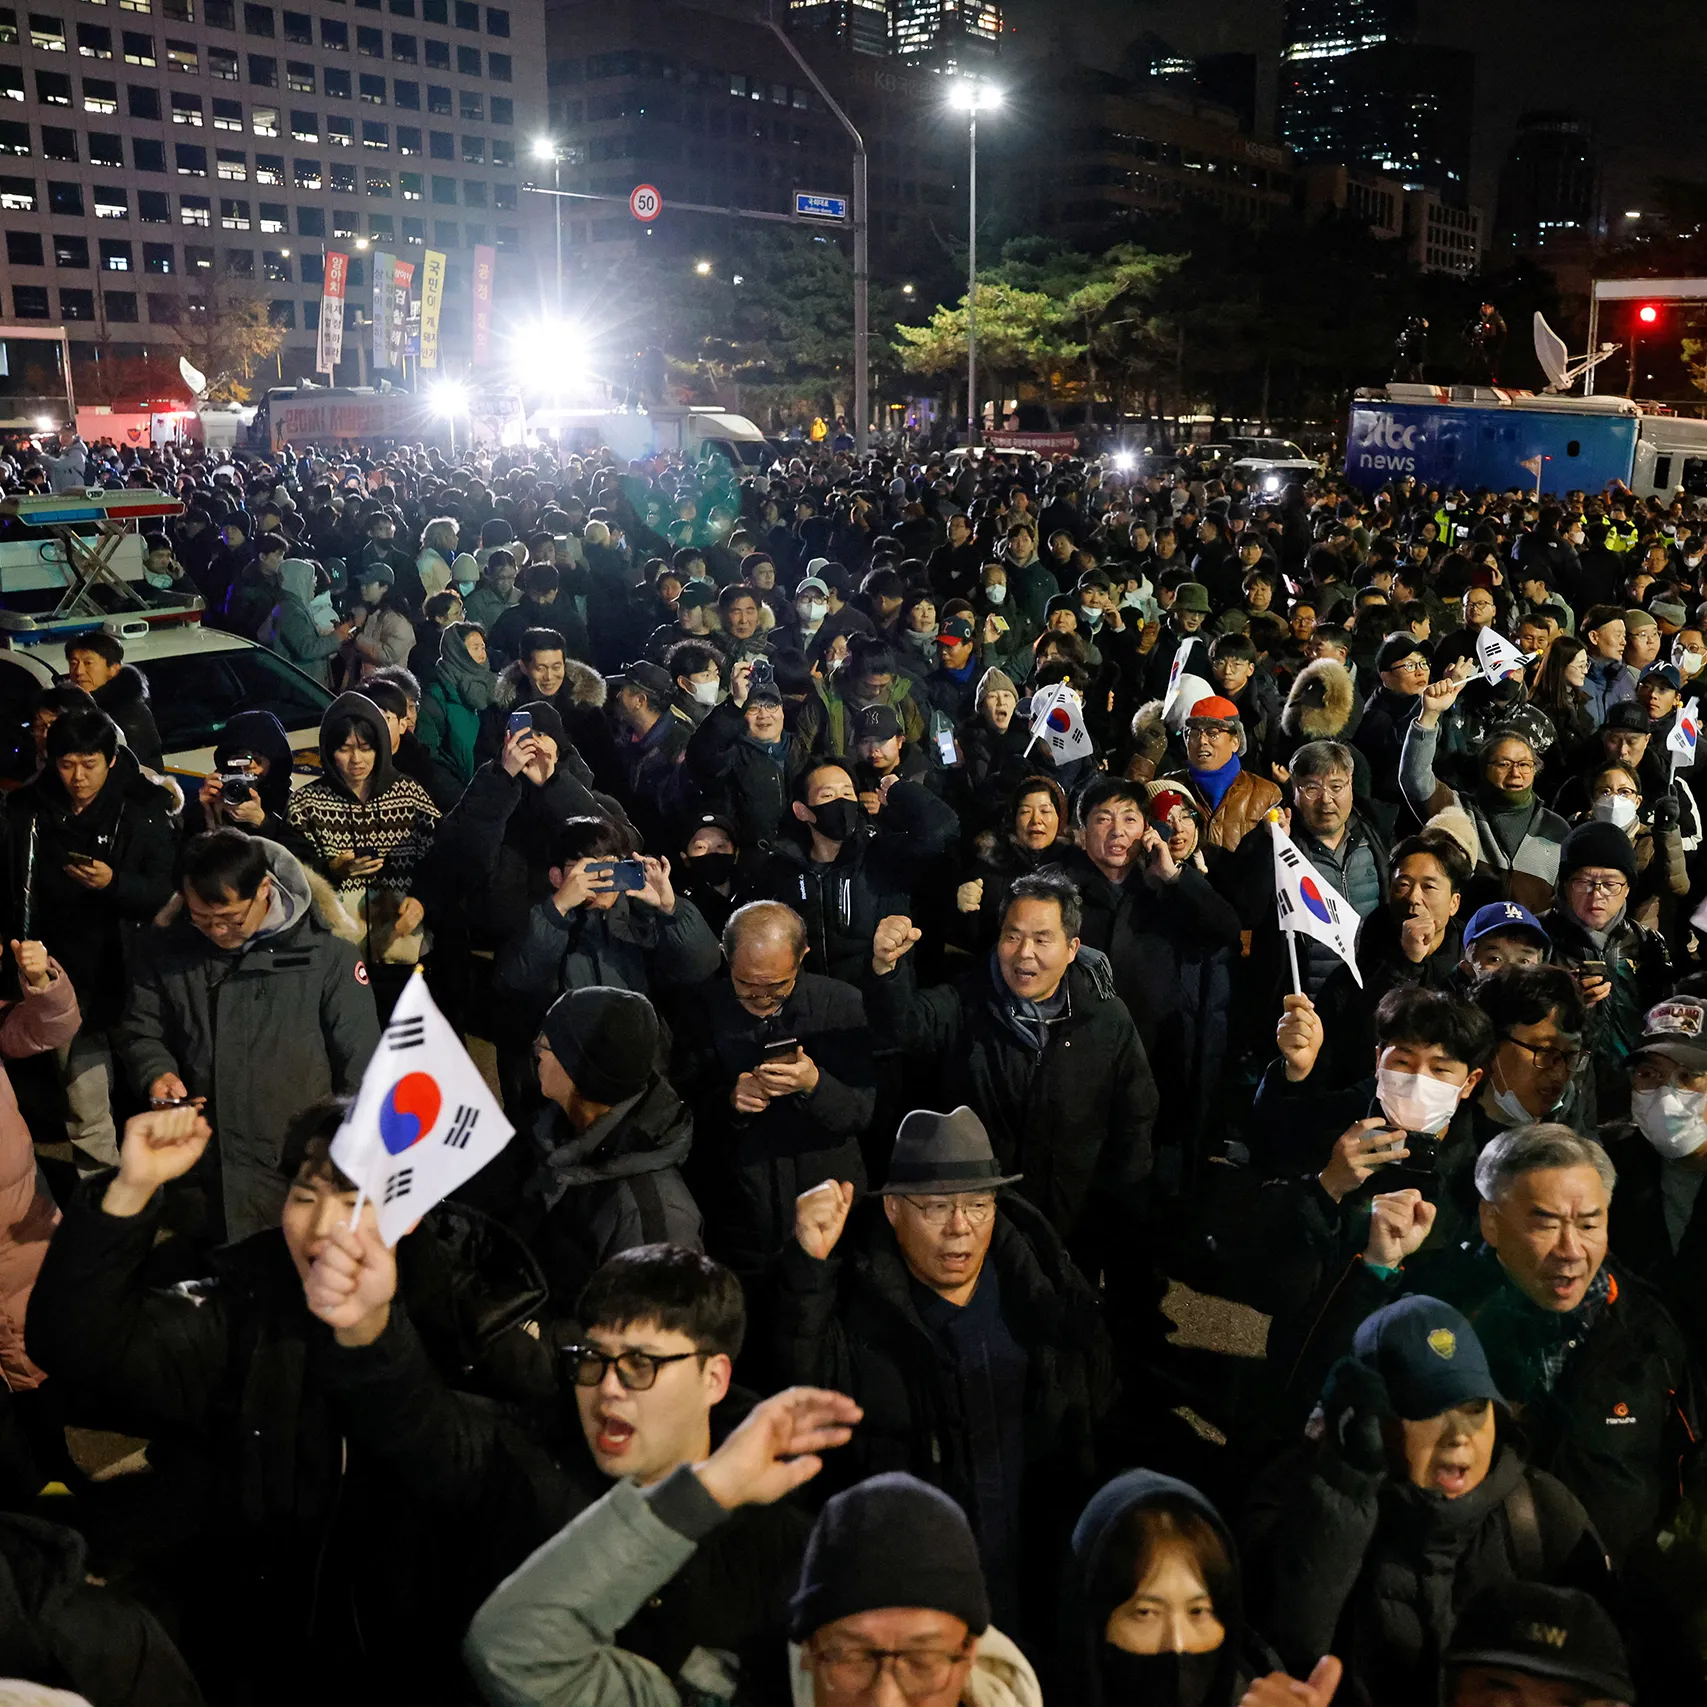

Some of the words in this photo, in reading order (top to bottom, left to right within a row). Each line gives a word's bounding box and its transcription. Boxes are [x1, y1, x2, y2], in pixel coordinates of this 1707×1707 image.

[638, 195, 654, 211] 50
[329, 256, 343, 294] 양아치
[478, 263, 489, 300] 공정
[427, 261, 440, 310] 국민이
[1360, 454, 1415, 472] news
[331, 567, 340, 578] LA
[865, 710, 879, 725] NY
[1503, 902, 1524, 920] LA
